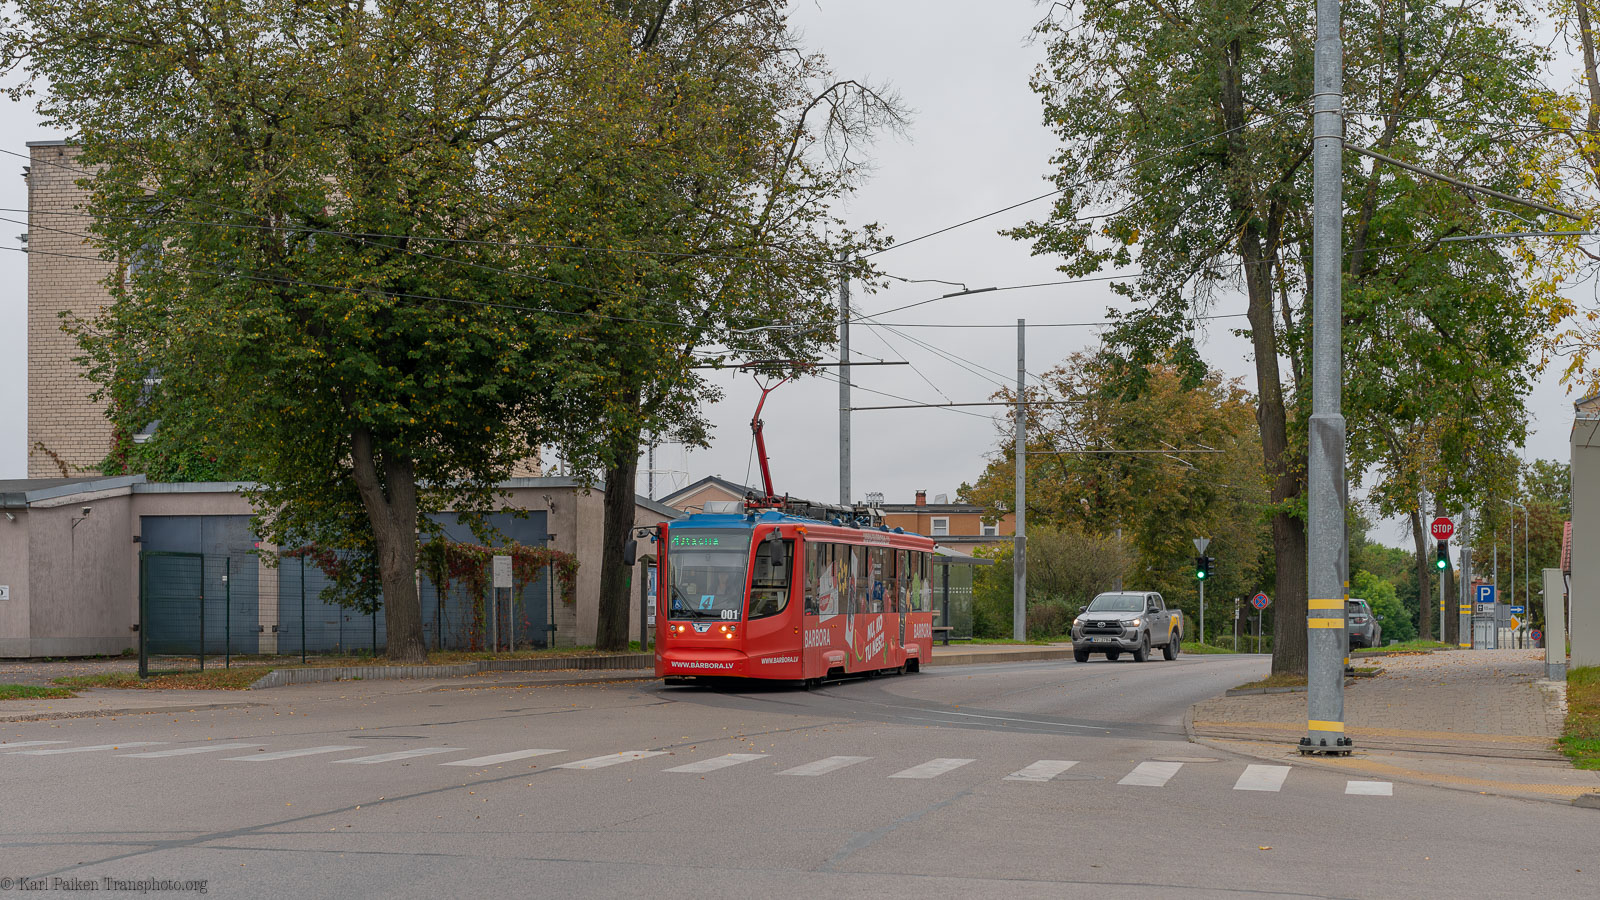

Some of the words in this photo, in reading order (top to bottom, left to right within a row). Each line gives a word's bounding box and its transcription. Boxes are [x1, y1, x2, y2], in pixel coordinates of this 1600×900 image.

[1433, 524, 1452, 533] STOP
[1480, 587, 1491, 601] P
[702, 596, 711, 608] 4
[720, 609, 738, 620] 001
[913, 623, 931, 639] BARBORA
[804, 628, 831, 649] BARBORA
[865, 642, 872, 663] TU
[671, 660, 734, 670] WWW.BARBORA.LV
[761, 655, 799, 665] WWW.BARBORA.LV
